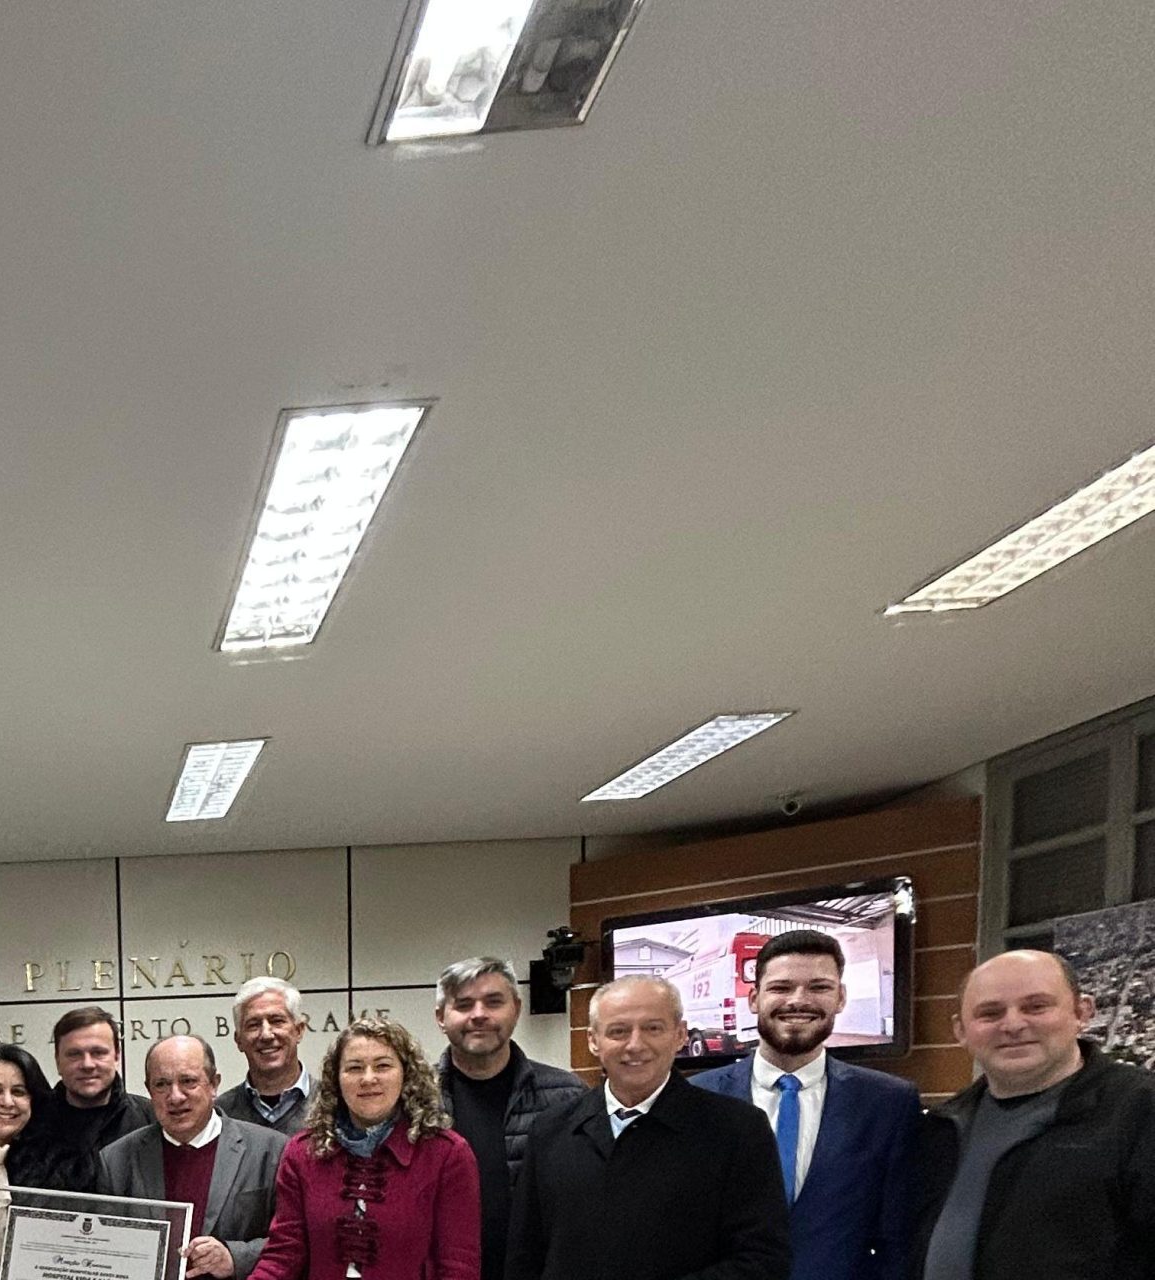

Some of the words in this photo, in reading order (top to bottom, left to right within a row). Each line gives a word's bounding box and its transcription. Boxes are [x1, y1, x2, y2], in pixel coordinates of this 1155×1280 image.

[23, 939, 296, 993] PLENÁRIO
[692, 980, 710, 999] 192
[42, 1272, 74, 1280] HOSPITAL
